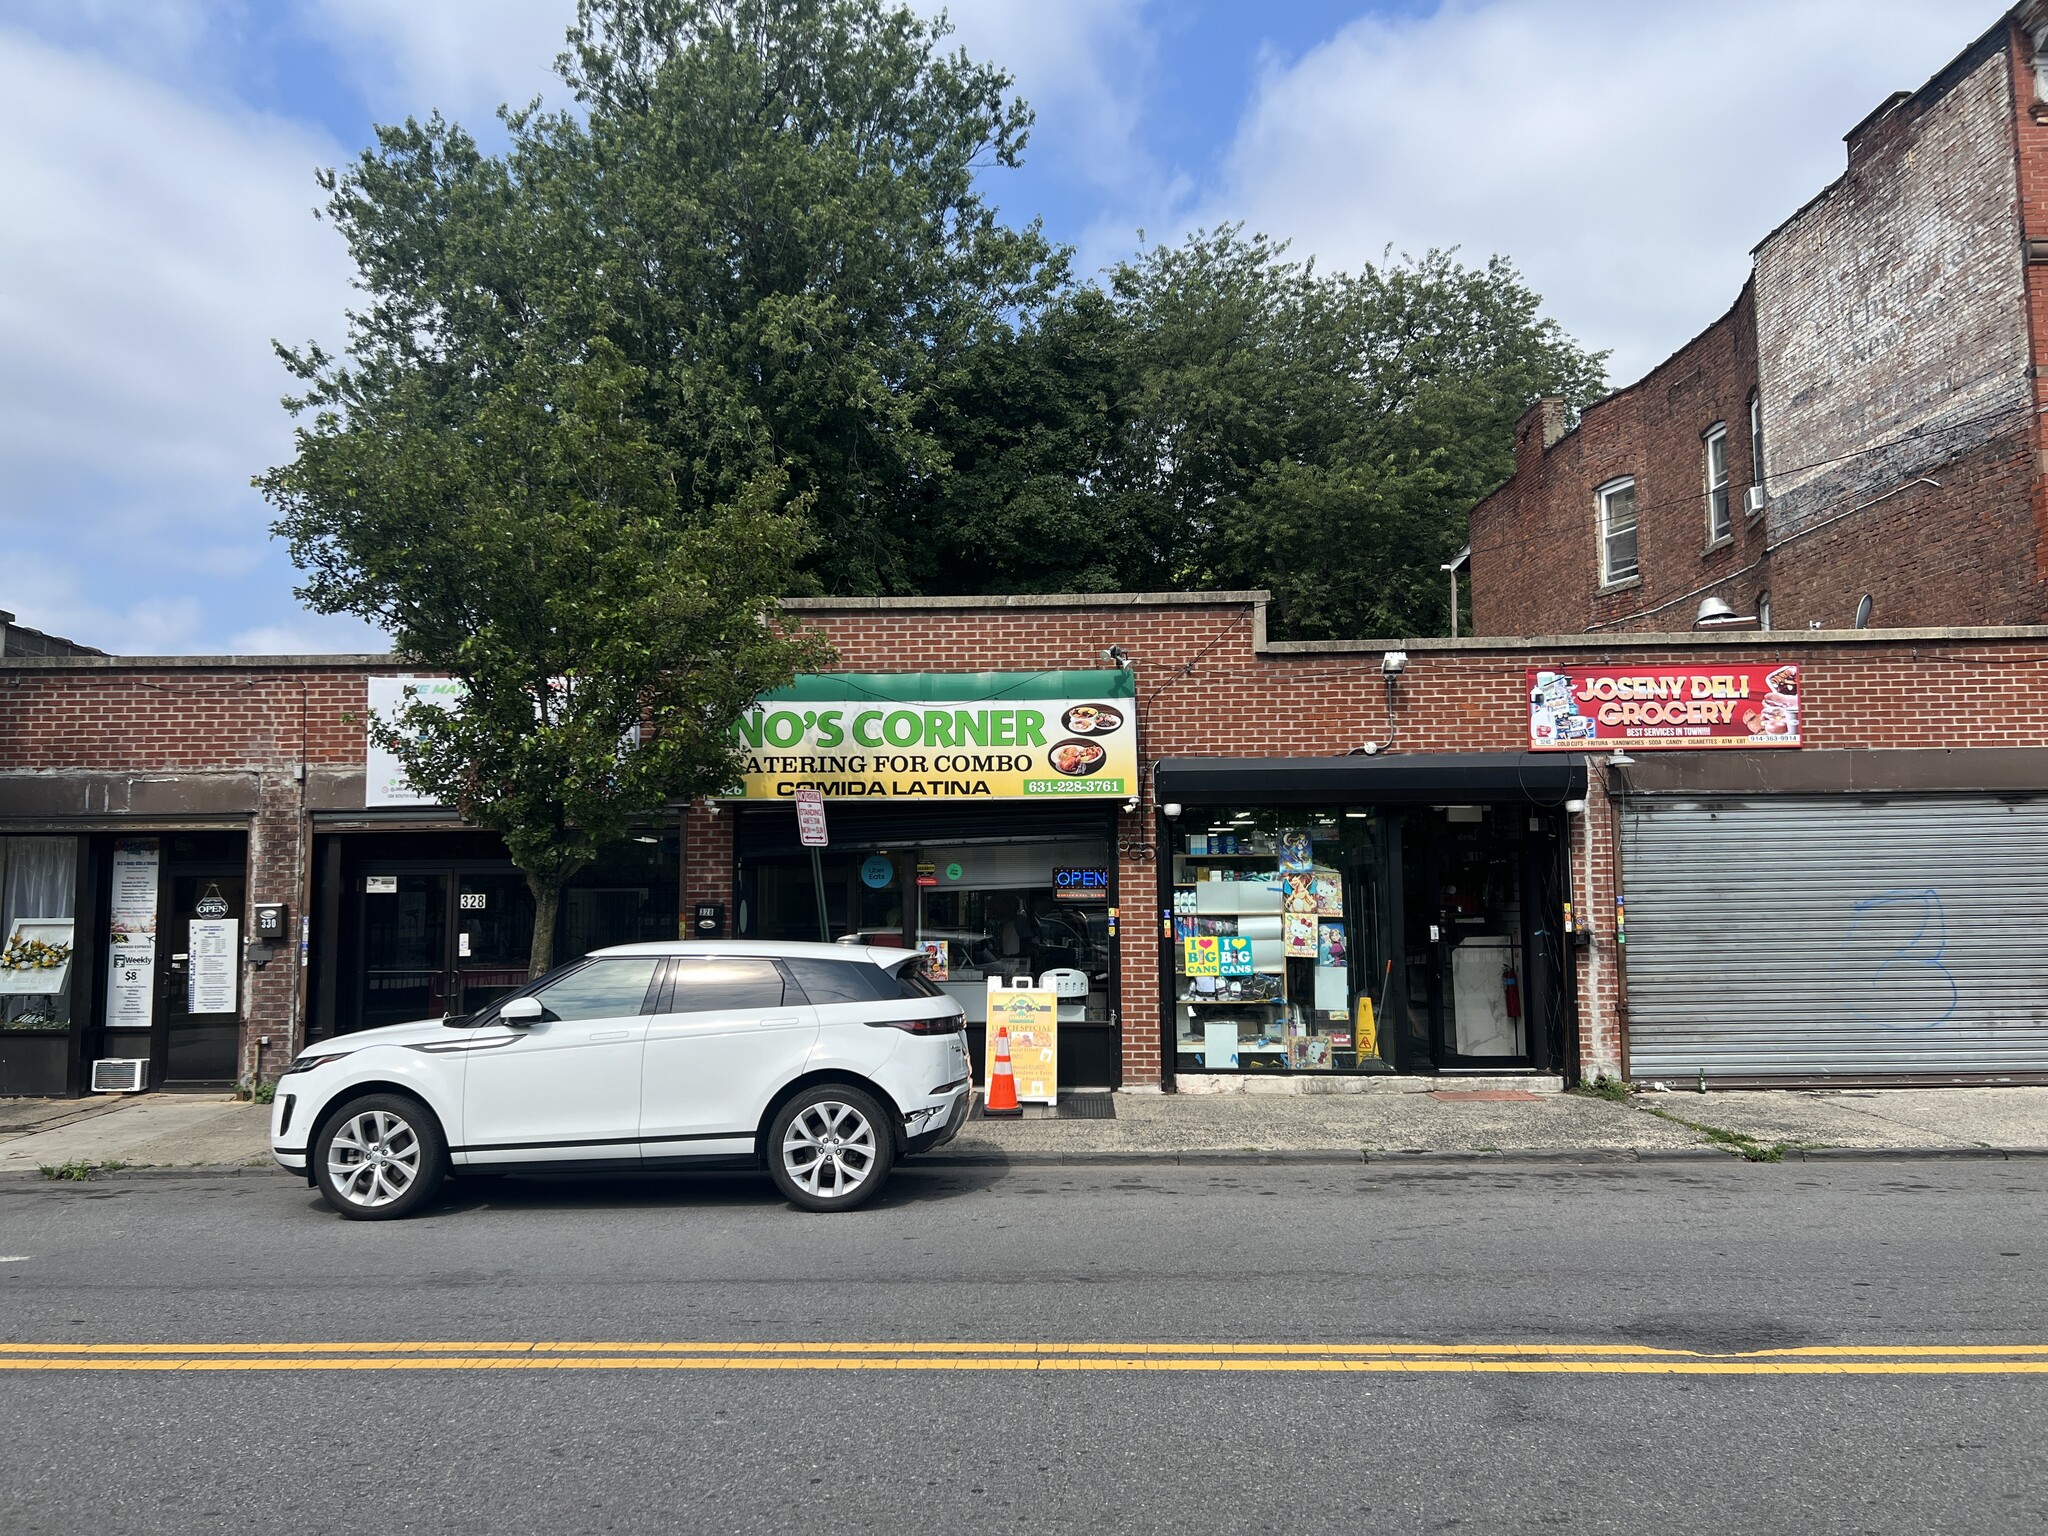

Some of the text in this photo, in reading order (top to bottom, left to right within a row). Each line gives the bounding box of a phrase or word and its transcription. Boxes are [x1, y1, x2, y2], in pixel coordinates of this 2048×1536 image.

[1577, 675, 1750, 702] JOSENY DELI
[1598, 700, 1737, 726] GROCERY
[719, 709, 1047, 748] NO'S CORNER
[1626, 728, 1643, 737] BEST
[1643, 727, 1674, 737] SERVICES
[1675, 727, 1683, 736] IN
[740, 754, 1033, 774] ATERING FOR COMBO
[892, 780, 992, 795] LATINA
[1028, 780, 1120, 793] 631-228-3761
[1057, 871, 1107, 886] OPEN
[462, 895, 484, 908] 328
[198, 905, 226, 913] OPEN
[261, 919, 277, 929] 330
[1190, 939, 1197, 950] I
[1222, 938, 1231, 951] I
[125, 956, 152, 966] Weekly
[1187, 965, 1218, 973] CANS
[1220, 964, 1252, 973] CANS
[125, 971, 137, 981] $8
